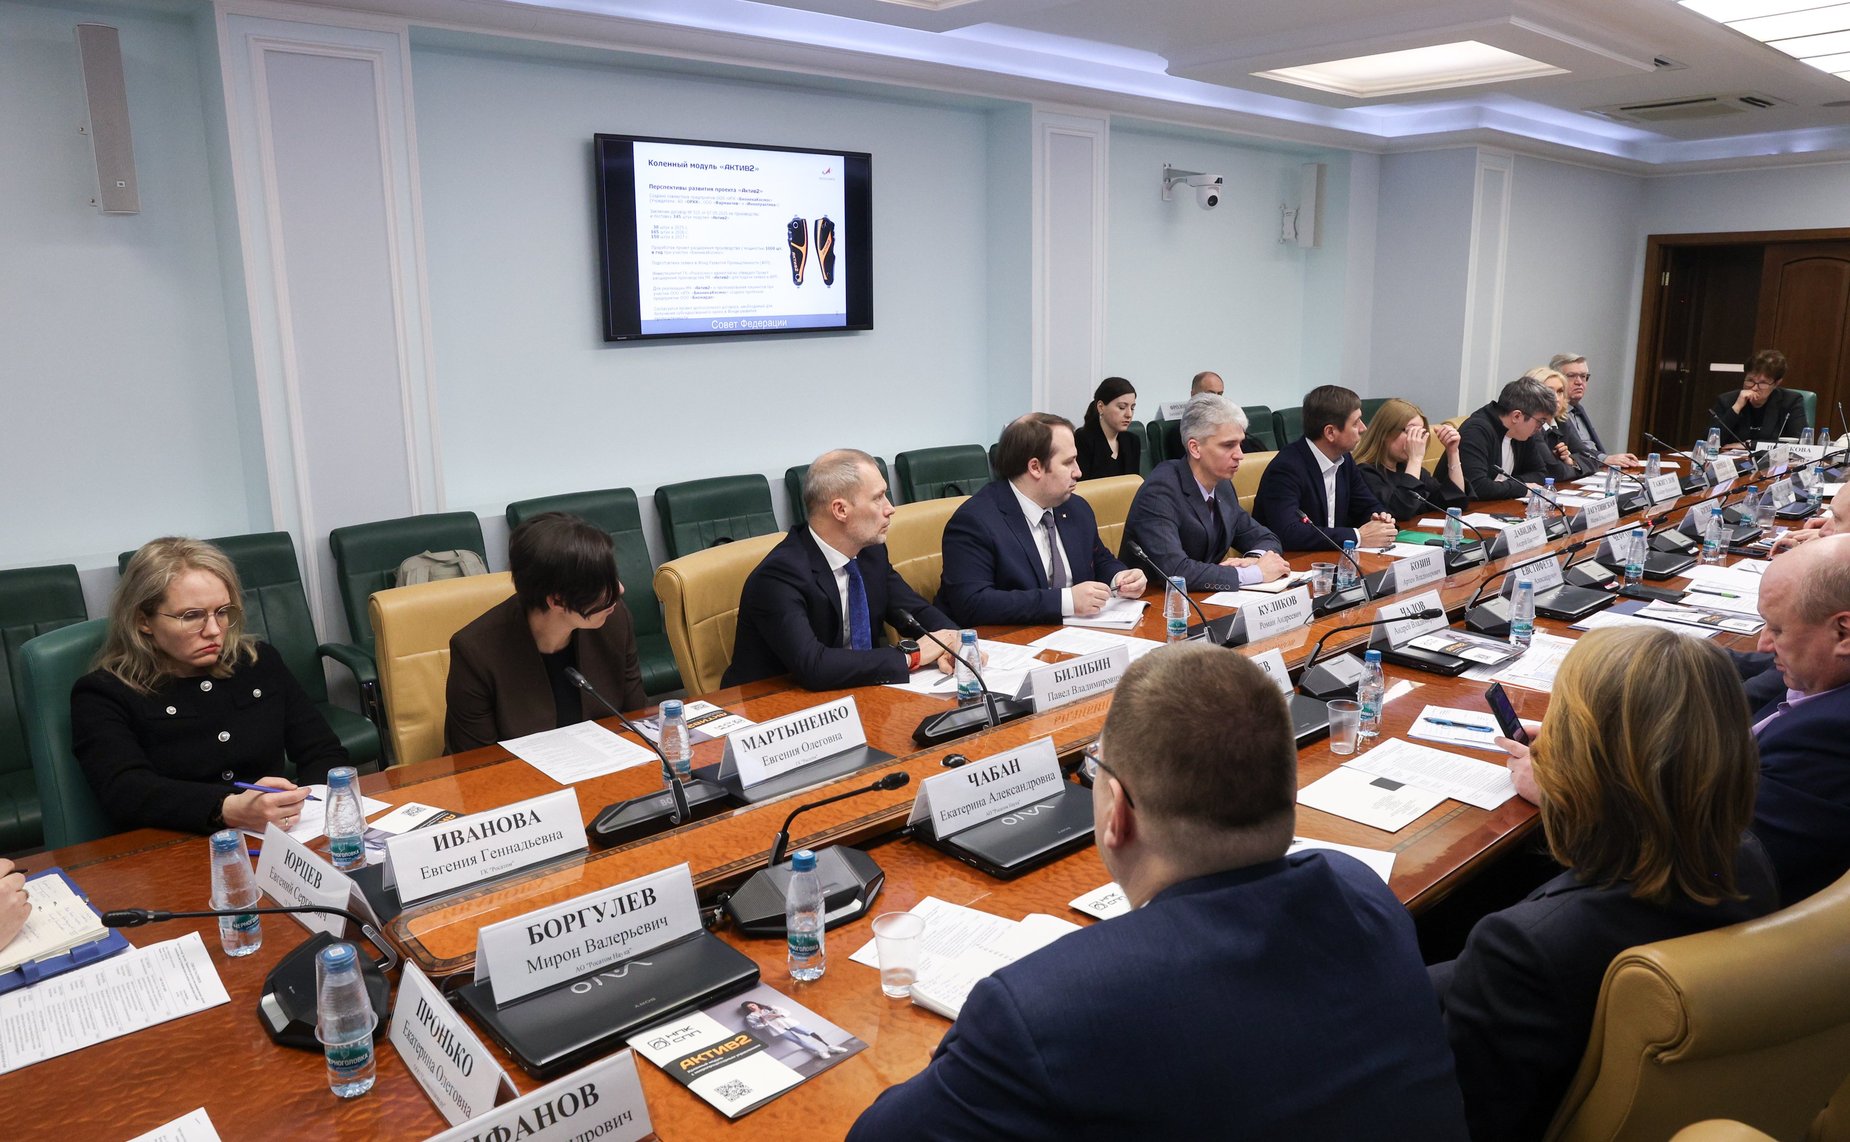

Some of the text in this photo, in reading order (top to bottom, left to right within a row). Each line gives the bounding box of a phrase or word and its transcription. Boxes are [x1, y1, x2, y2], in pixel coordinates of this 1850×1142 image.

[648, 159, 688, 168] Коленный
[689, 161, 718, 171] модуль
[711, 318, 788, 329] Совет Федерации
[1410, 557, 1431, 571] КОЗИН
[1257, 595, 1298, 616] КУЛИКОВ
[1054, 657, 1112, 683] БИЛИБИН
[1047, 690, 1070, 702] Павел
[741, 705, 849, 753] МАРТЫНЕНКО
[761, 732, 843, 767] Евгения Олеговна
[967, 758, 1021, 787] ЧАБАН
[940, 772, 1056, 821] Екатерина Александровна
[432, 809, 542, 853] ИВАНОВА
[1001, 804, 1056, 826] VAIO
[284, 849, 323, 889] ЮРЦЕВ
[420, 830, 564, 880] Евгения Геннадьевна
[269, 866, 294, 895] Евгений
[526, 887, 657, 946] БОРГУЛЕВ
[526, 916, 669, 975] Мирон Валерьевич
[416, 997, 474, 1077] ПРОНЬКО
[679, 1034, 753, 1070] АКТИВ2
[402, 1020, 436, 1074] Екатерина
[435, 1064, 472, 1119] Олеговна
